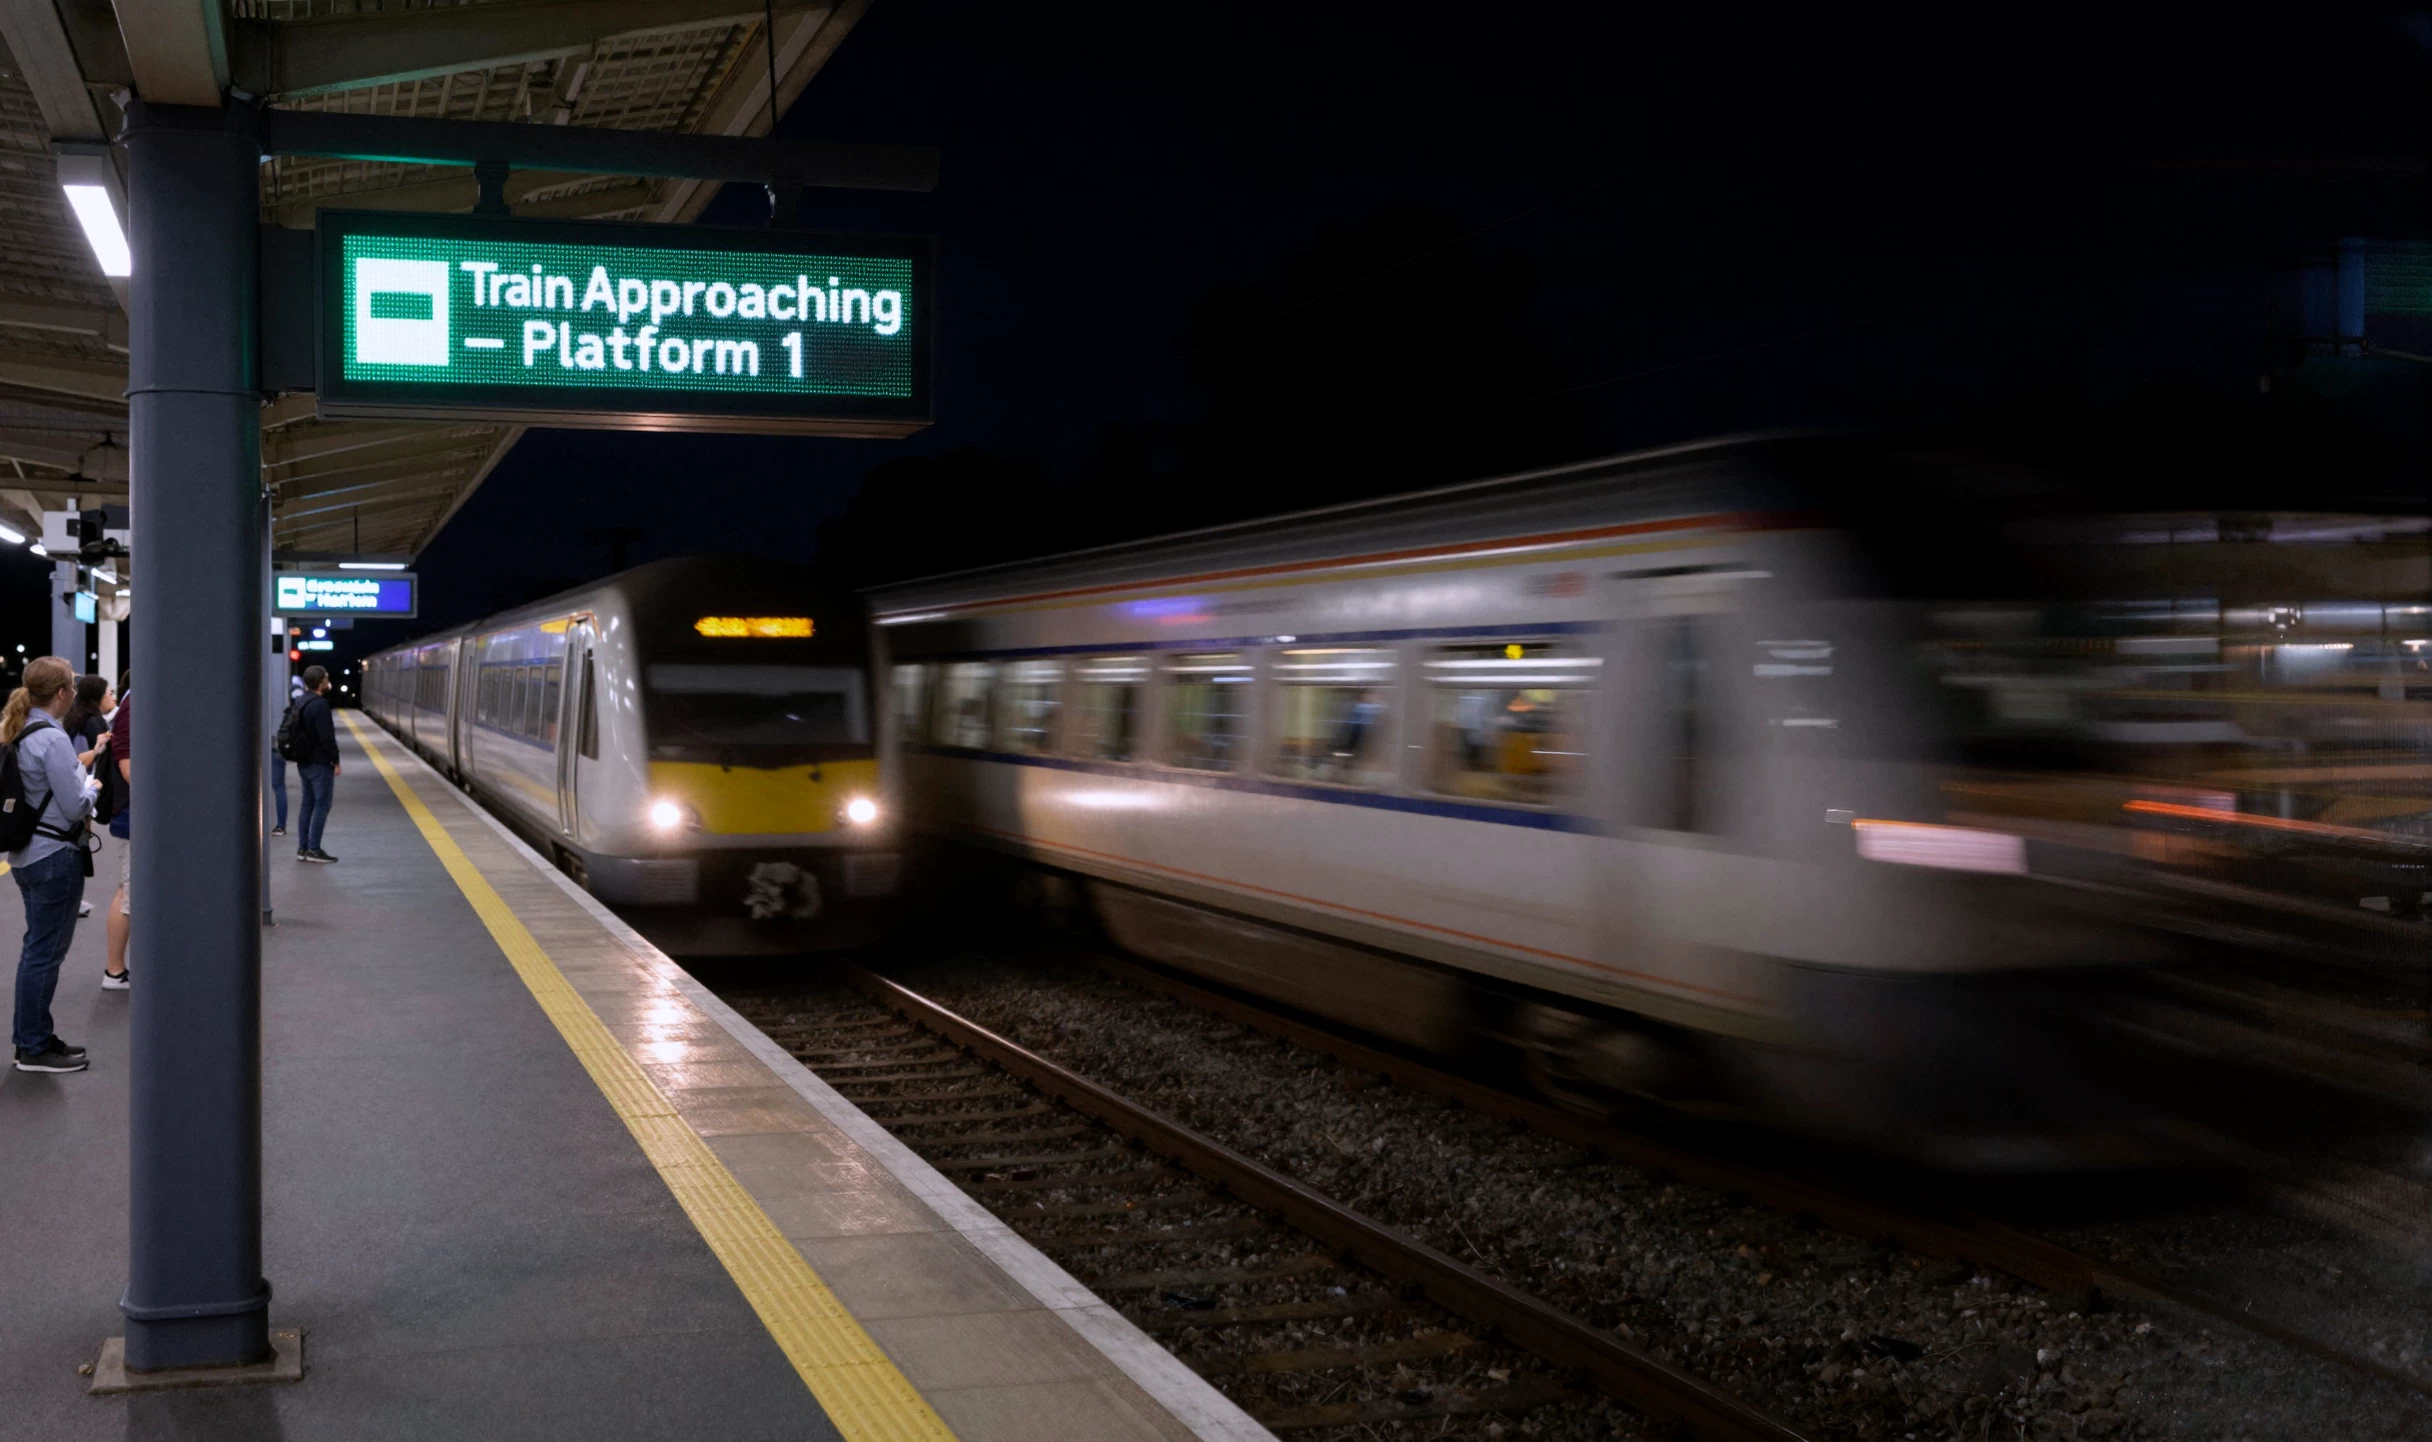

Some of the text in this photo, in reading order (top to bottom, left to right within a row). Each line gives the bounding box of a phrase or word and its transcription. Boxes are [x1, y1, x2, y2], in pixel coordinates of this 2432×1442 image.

[461, 261, 902, 336] Train Approaching
[523, 320, 759, 377] Platform
[782, 331, 802, 378] 1
